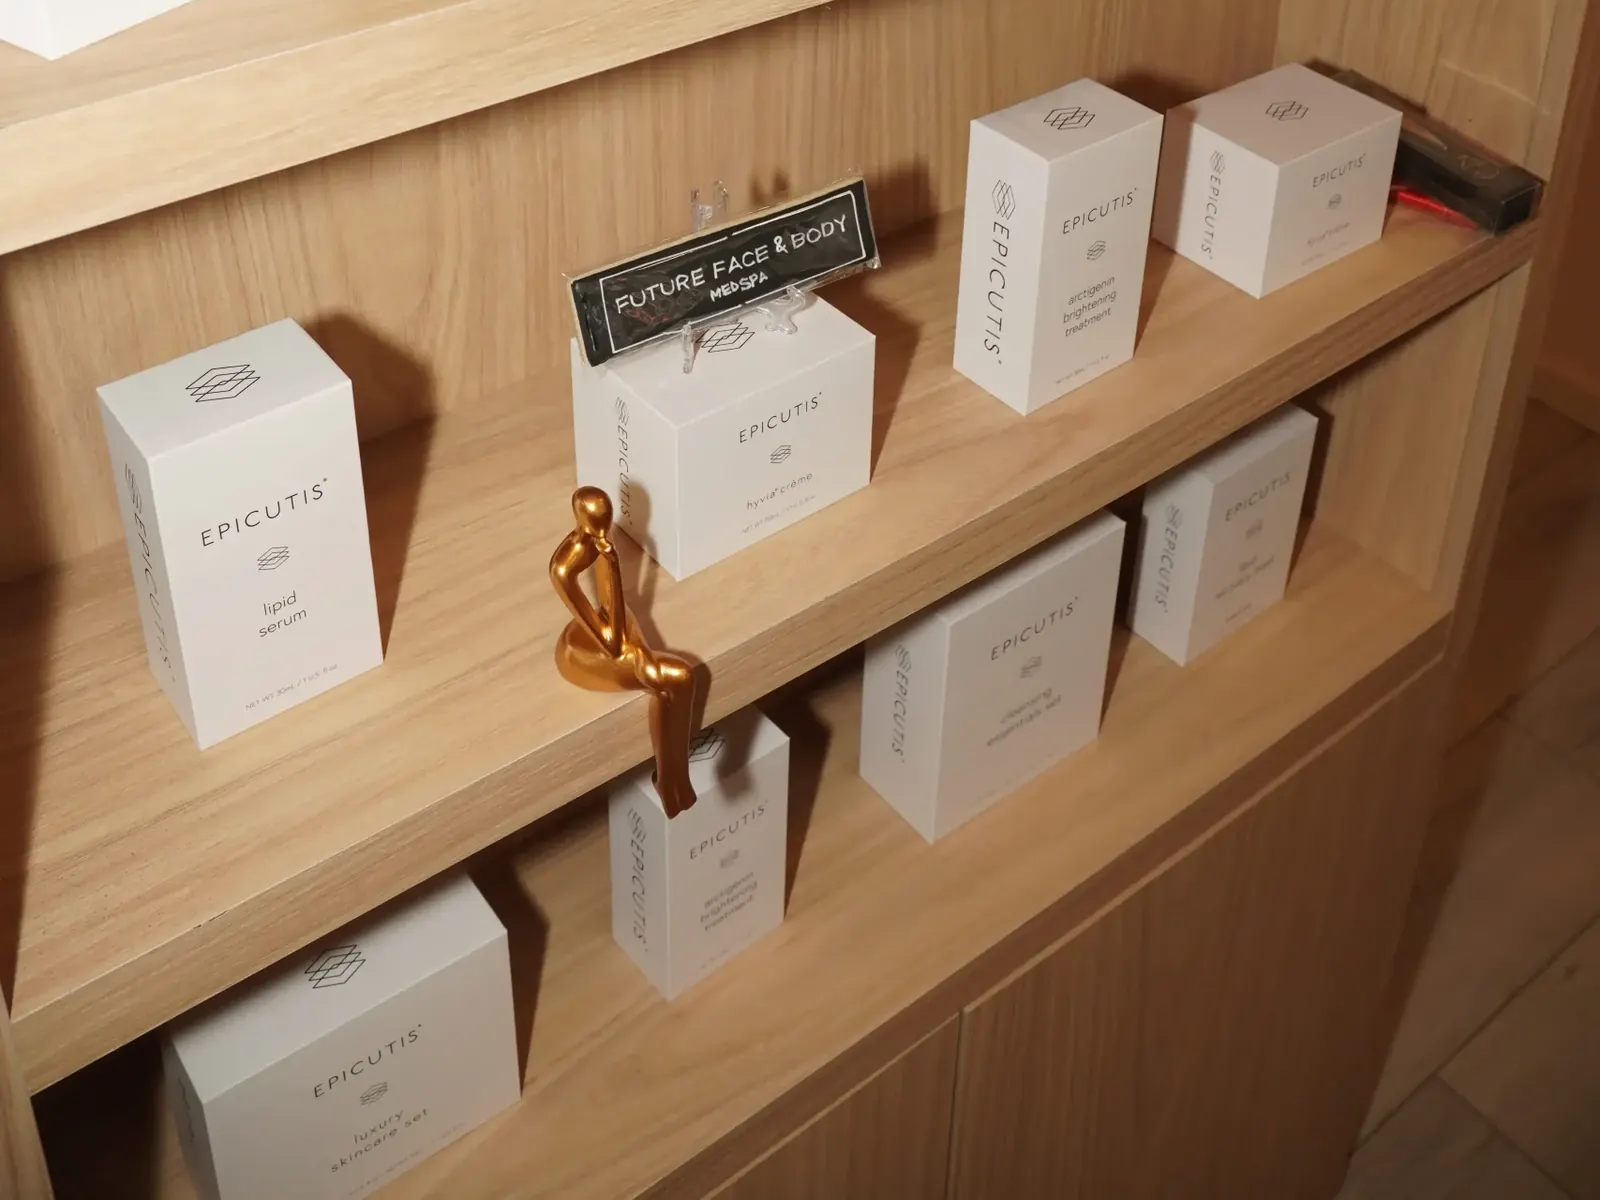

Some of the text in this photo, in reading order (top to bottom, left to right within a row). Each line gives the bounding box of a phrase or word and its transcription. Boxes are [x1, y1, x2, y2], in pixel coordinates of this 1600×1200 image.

[615, 213, 847, 314] FUTURE FACE & BODY
[709, 271, 769, 302] MEDSPA
[1068, 275, 1116, 306] arctigenin
[1063, 290, 1118, 324] brightening
[1065, 307, 1112, 338] treatment
[780, 472, 813, 494] crème
[263, 589, 297, 616] lipid
[259, 608, 308, 638] serum
[331, 1127, 398, 1174] skincare
[404, 1107, 429, 1129] set
[353, 1109, 404, 1145] luxury
